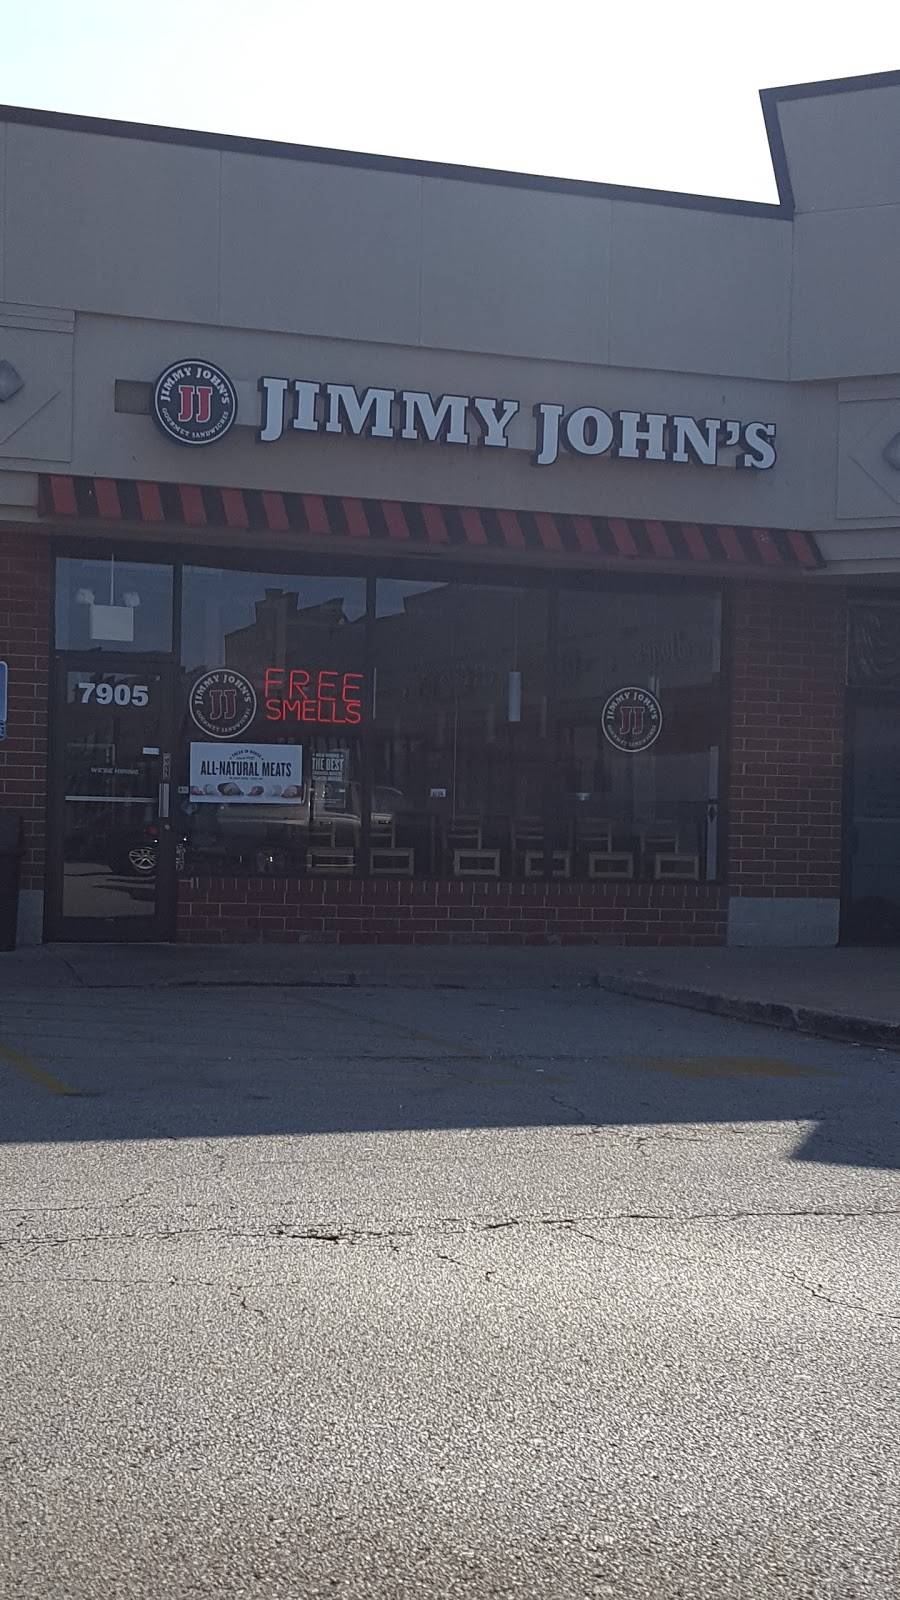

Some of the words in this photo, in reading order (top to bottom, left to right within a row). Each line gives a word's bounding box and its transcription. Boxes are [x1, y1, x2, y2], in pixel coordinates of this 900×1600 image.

[161, 367, 192, 402] JIMMY
[196, 367, 230, 405] JOHN'S
[178, 385, 213, 423] JJ
[257, 376, 520, 447] JIMMY
[535, 402, 777, 470] JOHN'S
[78, 682, 149, 706] 7905
[194, 674, 219, 705] JIMMY
[223, 674, 250, 703] JOHN'S
[265, 668, 364, 702] FREE
[209, 689, 236, 720] JJ
[266, 699, 362, 724] SMELLS
[607, 692, 630, 720] JIMMY
[620, 706, 645, 734] JJ
[200, 760, 259, 777] ALL-NATURAL
[262, 762, 292, 777] MEATS
